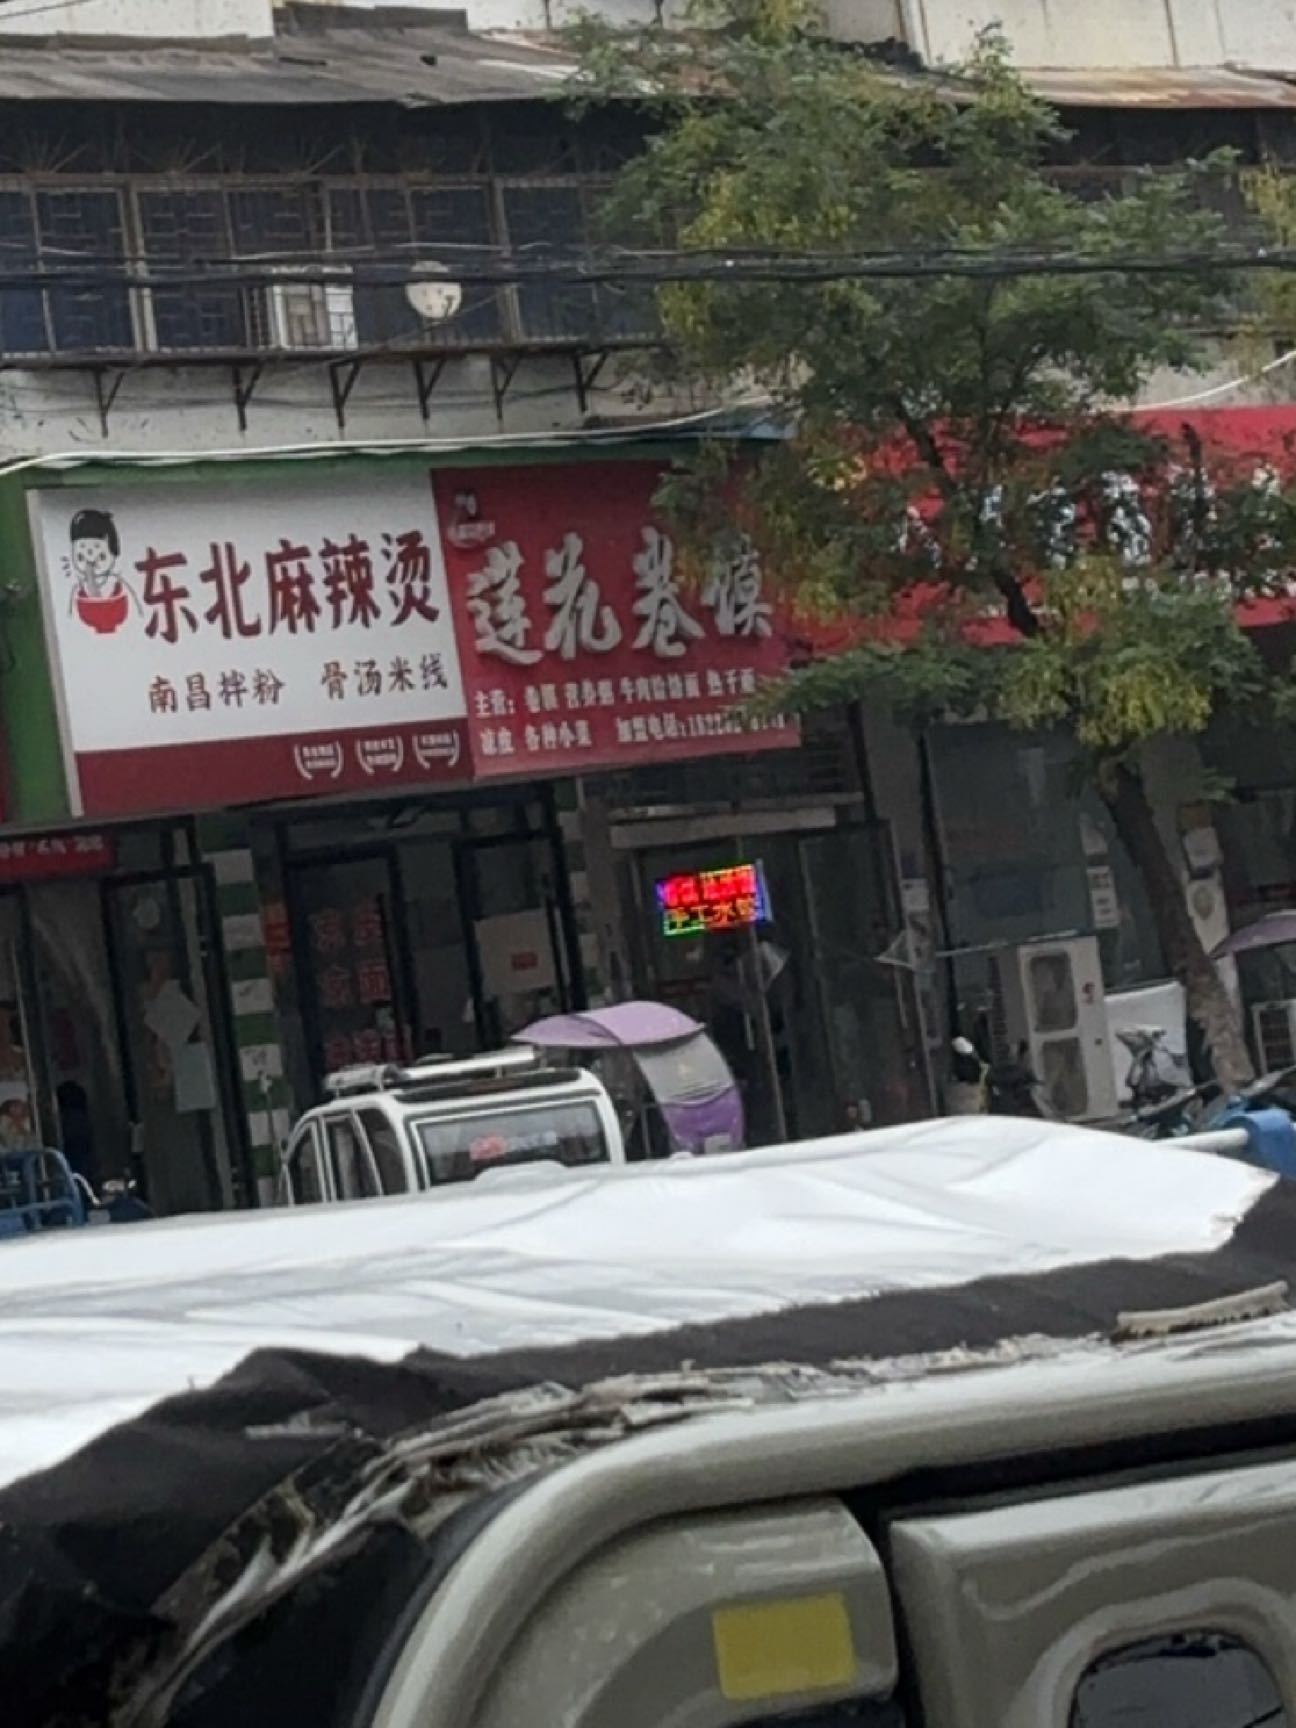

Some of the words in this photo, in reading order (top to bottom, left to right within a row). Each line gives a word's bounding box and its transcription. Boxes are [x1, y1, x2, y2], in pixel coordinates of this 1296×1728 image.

[135, 530, 440, 644] 东北麻辣烫
[148, 669, 285, 714] 南昌拌粉
[321, 653, 448, 700] 骨汤米线
